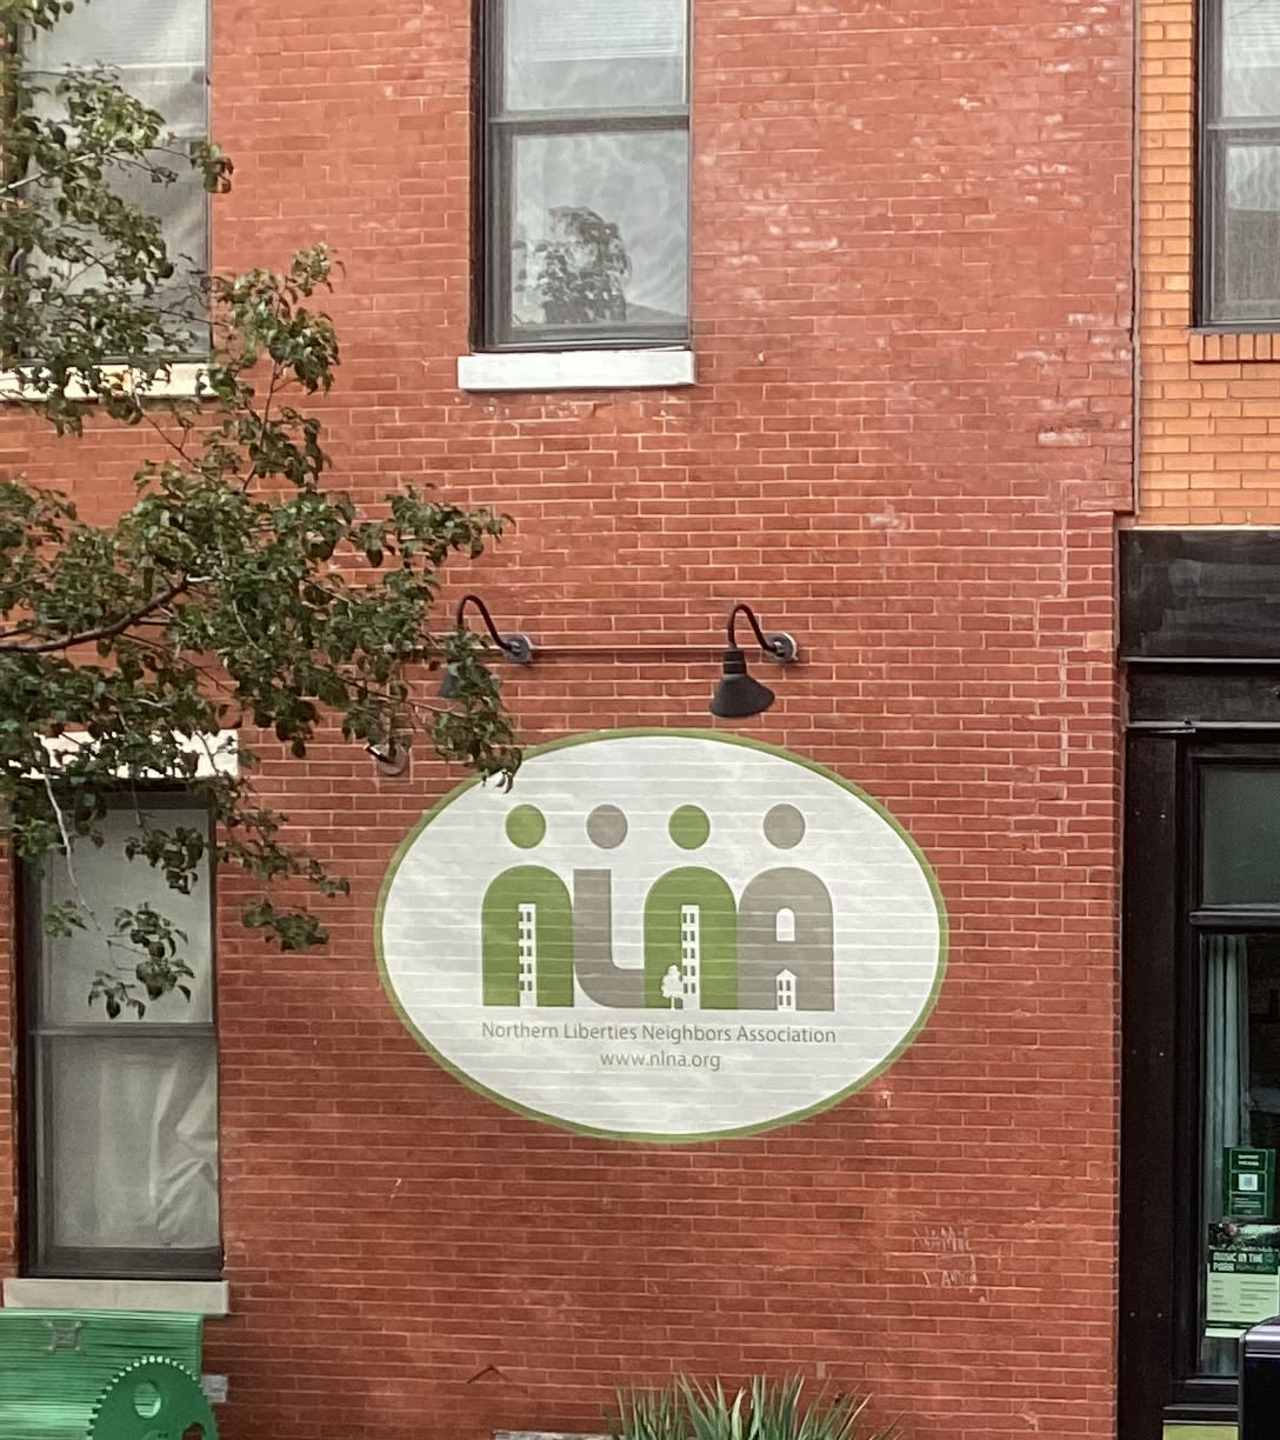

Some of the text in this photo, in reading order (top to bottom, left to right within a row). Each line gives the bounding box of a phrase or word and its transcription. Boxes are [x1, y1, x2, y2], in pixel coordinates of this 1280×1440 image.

[482, 1022, 836, 1045] Northern Liberties Neighbors Association
[600, 1051, 721, 1072] www.nlna.org
